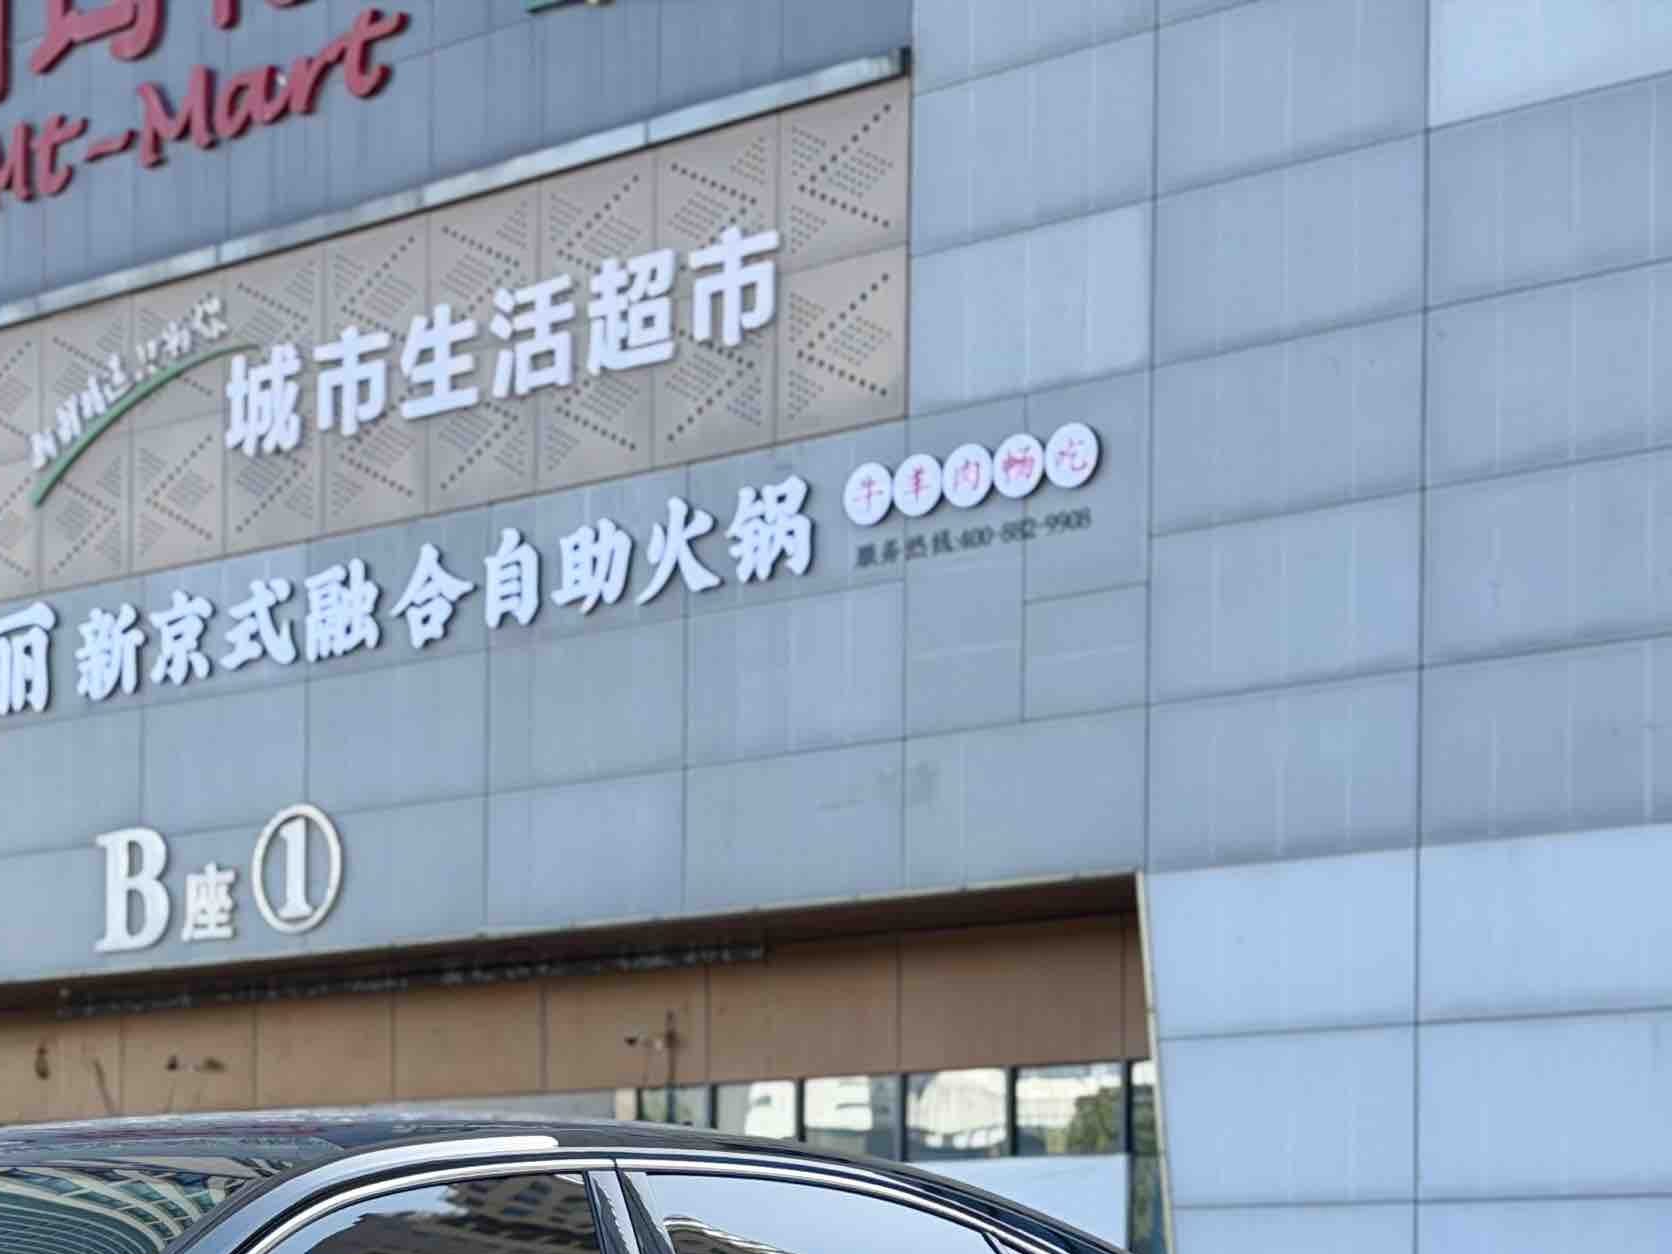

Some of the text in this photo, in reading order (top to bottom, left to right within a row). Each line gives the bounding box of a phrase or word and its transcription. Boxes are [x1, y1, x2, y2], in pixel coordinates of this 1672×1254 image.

[226, 226, 780, 456] 城市生活超市
[74, 475, 815, 702] 新京式融合自助火锅
